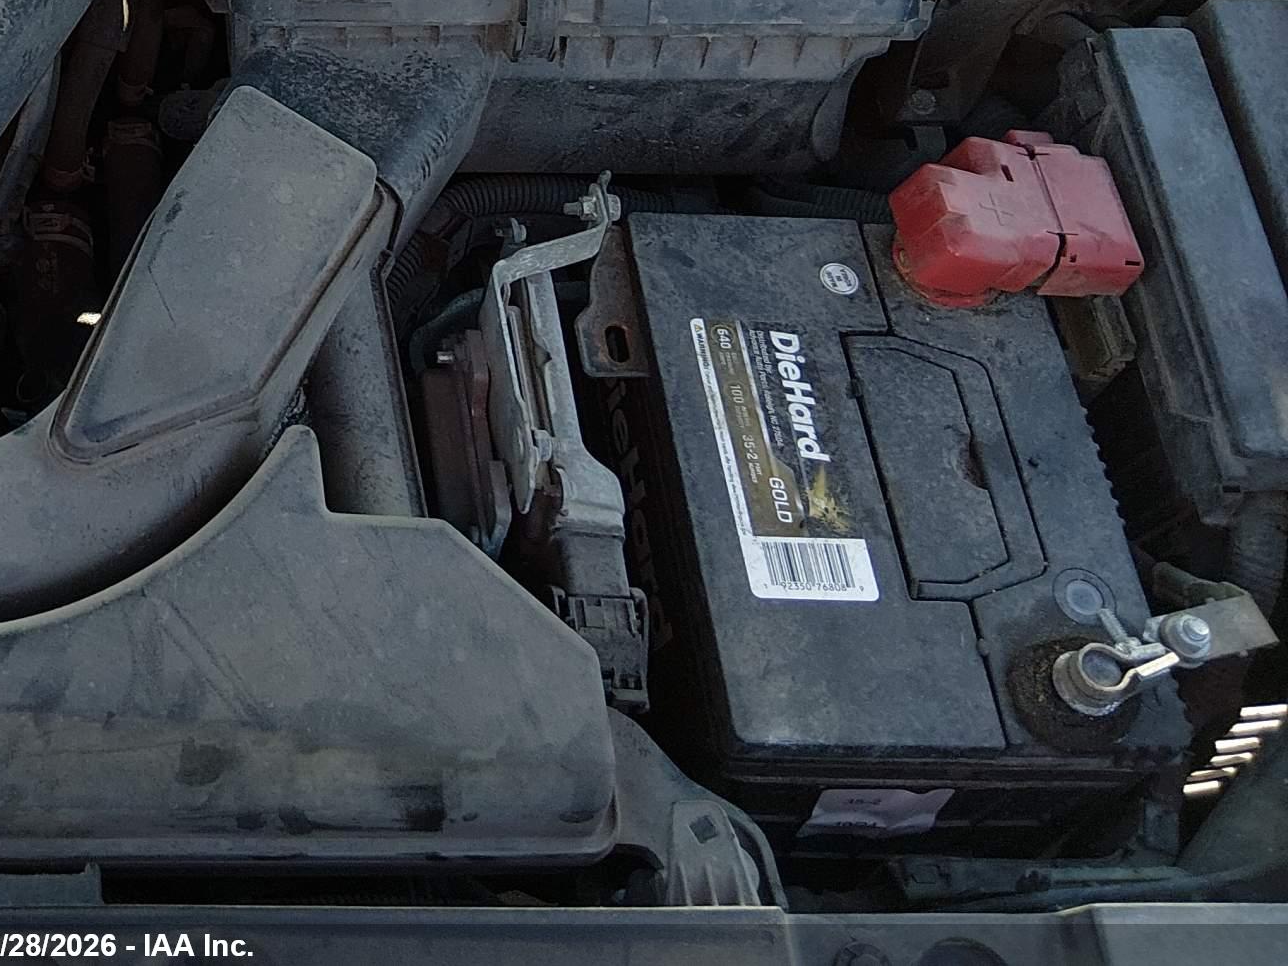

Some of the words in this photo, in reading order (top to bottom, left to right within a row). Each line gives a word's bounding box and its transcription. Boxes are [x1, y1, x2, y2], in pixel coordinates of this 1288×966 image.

[716, 328, 731, 348] 640
[730, 385, 744, 402] 100
[768, 330, 831, 462] DieHard
[741, 434, 758, 459] 35-2
[769, 477, 793, 522] GOLD
